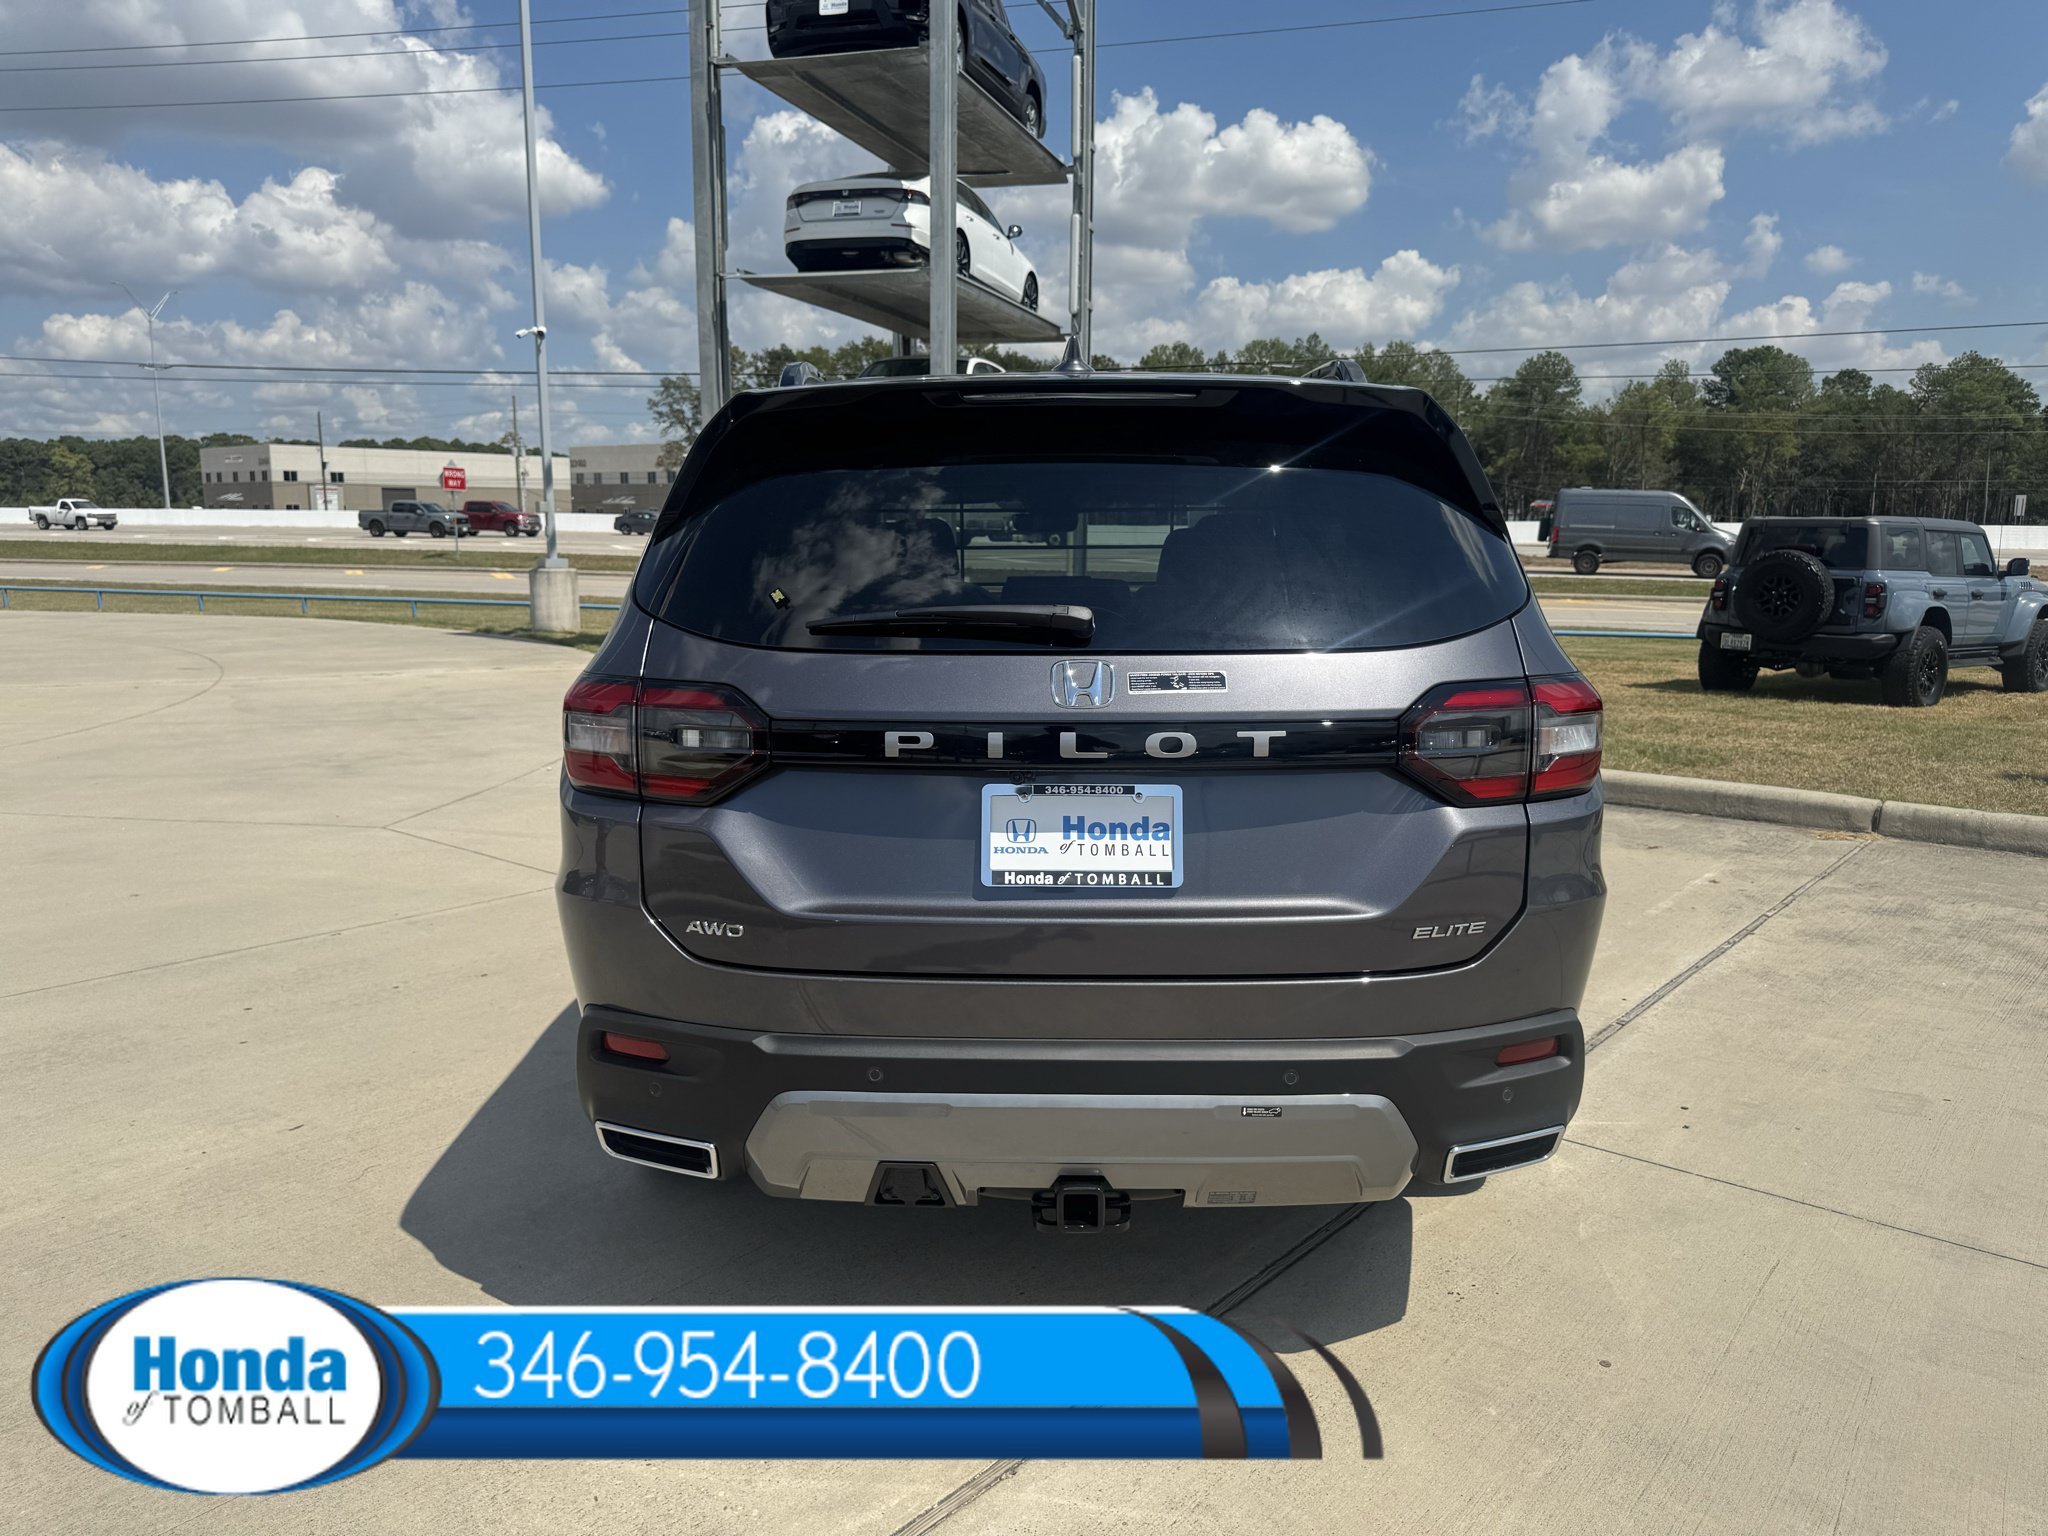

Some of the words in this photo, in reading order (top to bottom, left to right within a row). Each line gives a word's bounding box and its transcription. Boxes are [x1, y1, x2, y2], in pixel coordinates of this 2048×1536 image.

[448, 479, 462, 487] WAY
[884, 731, 1287, 759] PILOT
[1044, 786, 1124, 795] 346-954-8400
[1062, 815, 1170, 841] Honda
[993, 846, 1049, 855] HONDA
[1059, 840, 1077, 854] of
[1077, 843, 1169, 857] TOMBALL
[1004, 871, 1054, 885] Honda
[1057, 872, 1072, 885] of
[1075, 873, 1165, 885] TOMBALL
[685, 920, 745, 938] AWD
[1412, 921, 1487, 940] ELITE
